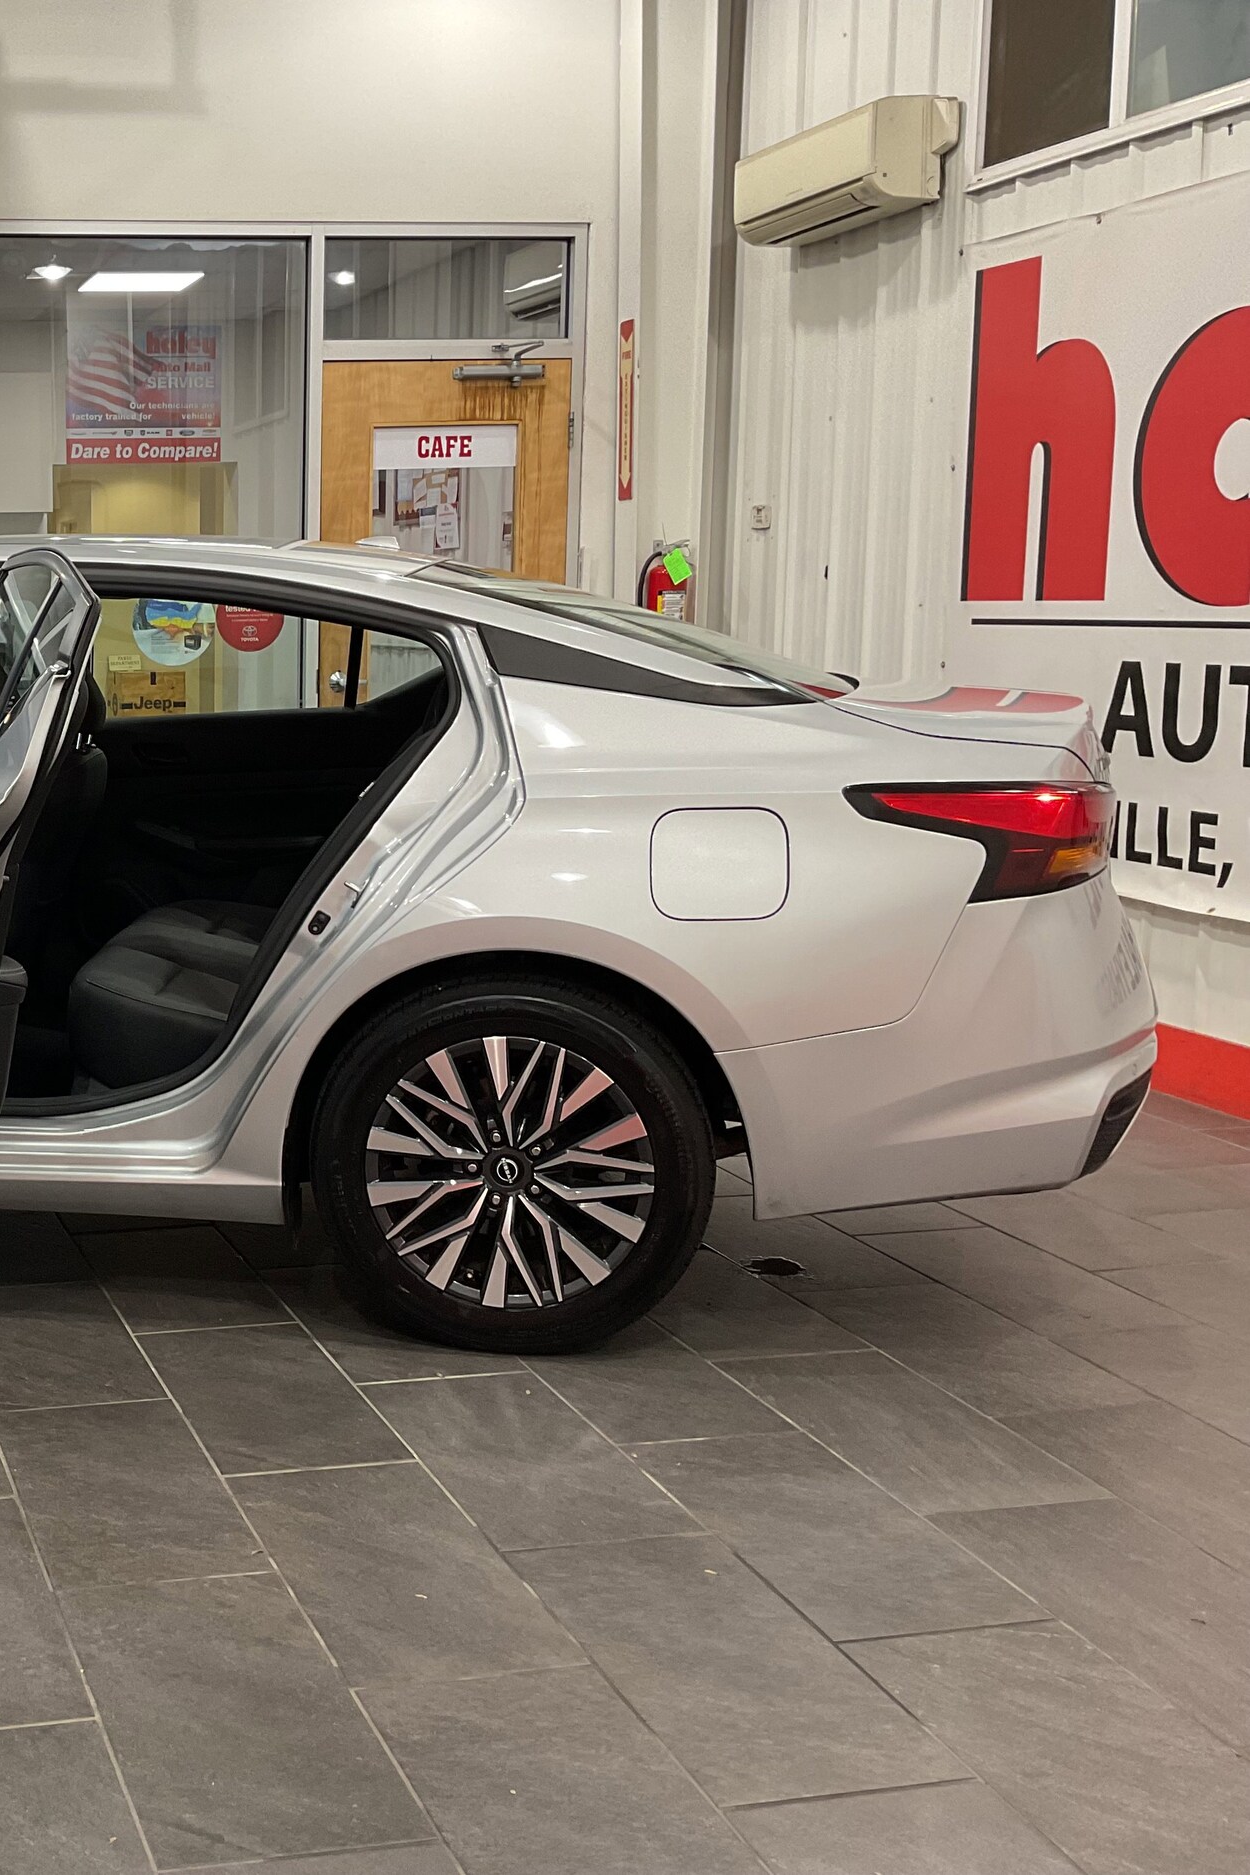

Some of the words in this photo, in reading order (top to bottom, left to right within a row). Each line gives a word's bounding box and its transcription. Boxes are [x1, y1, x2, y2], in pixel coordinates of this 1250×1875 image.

[147, 375, 215, 389] SERVICE
[129, 402, 145, 410] Our
[72, 413, 103, 421] factory
[105, 413, 136, 421] trained
[70, 443, 110, 459] Dare
[115, 443, 133, 459] to
[137, 442, 219, 461] Compare!
[417, 435, 472, 458] CAFE
[133, 696, 172, 711] Jeep
